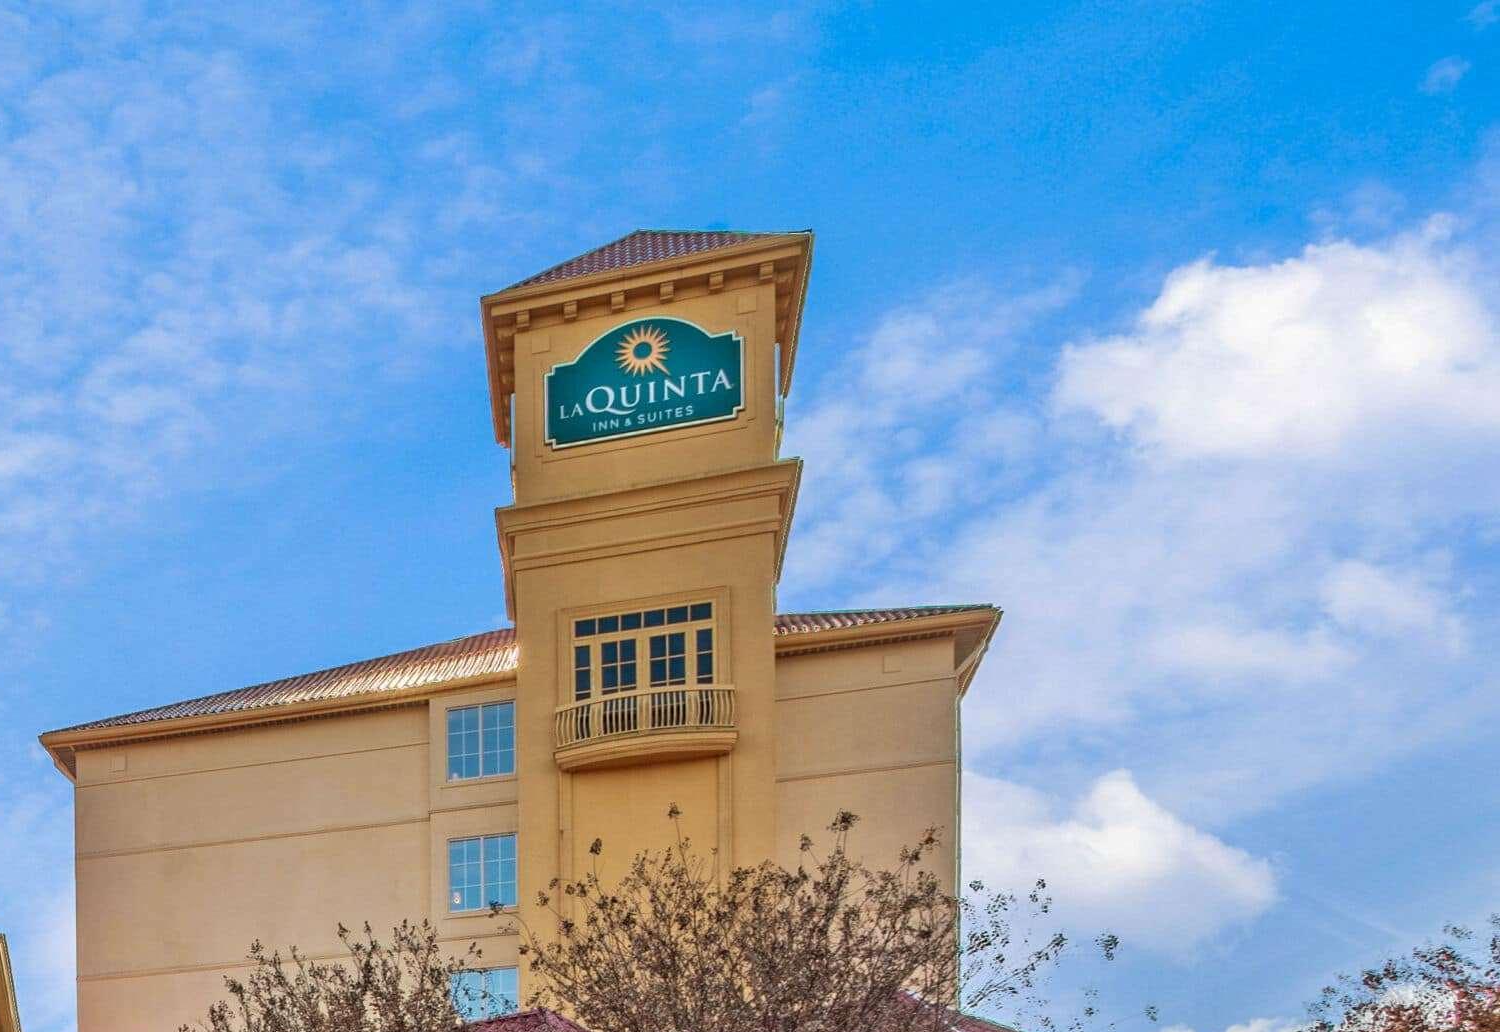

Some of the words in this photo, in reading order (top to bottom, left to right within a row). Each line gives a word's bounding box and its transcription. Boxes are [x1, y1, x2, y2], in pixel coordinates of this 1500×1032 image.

[585, 368, 732, 415] QUINTA
[592, 418, 620, 432] INN
[637, 405, 694, 425] SUITES
